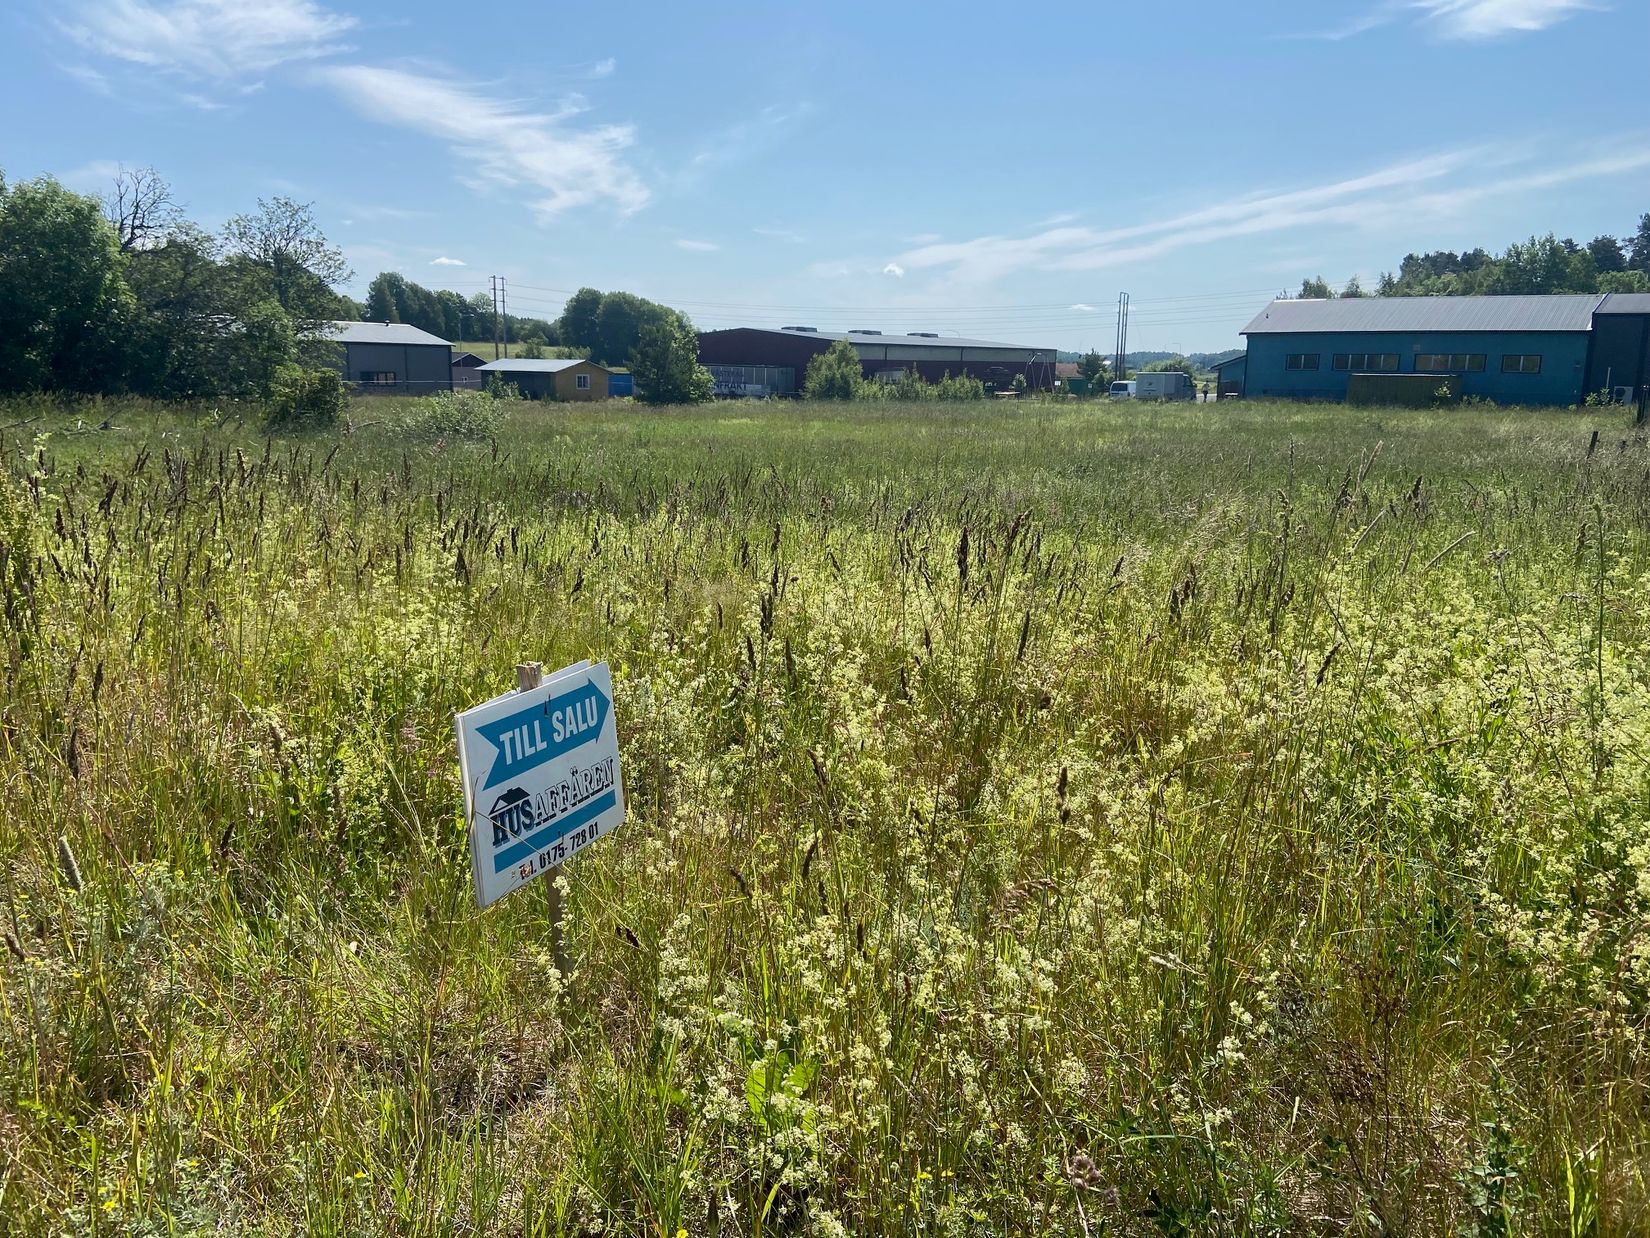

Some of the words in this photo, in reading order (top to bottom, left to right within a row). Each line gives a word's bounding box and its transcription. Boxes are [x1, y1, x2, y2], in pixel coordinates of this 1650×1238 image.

[499, 719, 547, 765] TILL
[552, 695, 598, 743] SALU
[490, 756, 615, 848] HUSAFFÄREN
[519, 860, 537, 880] Tl.
[570, 829, 586, 851] 728
[588, 821, 599, 839] 01
